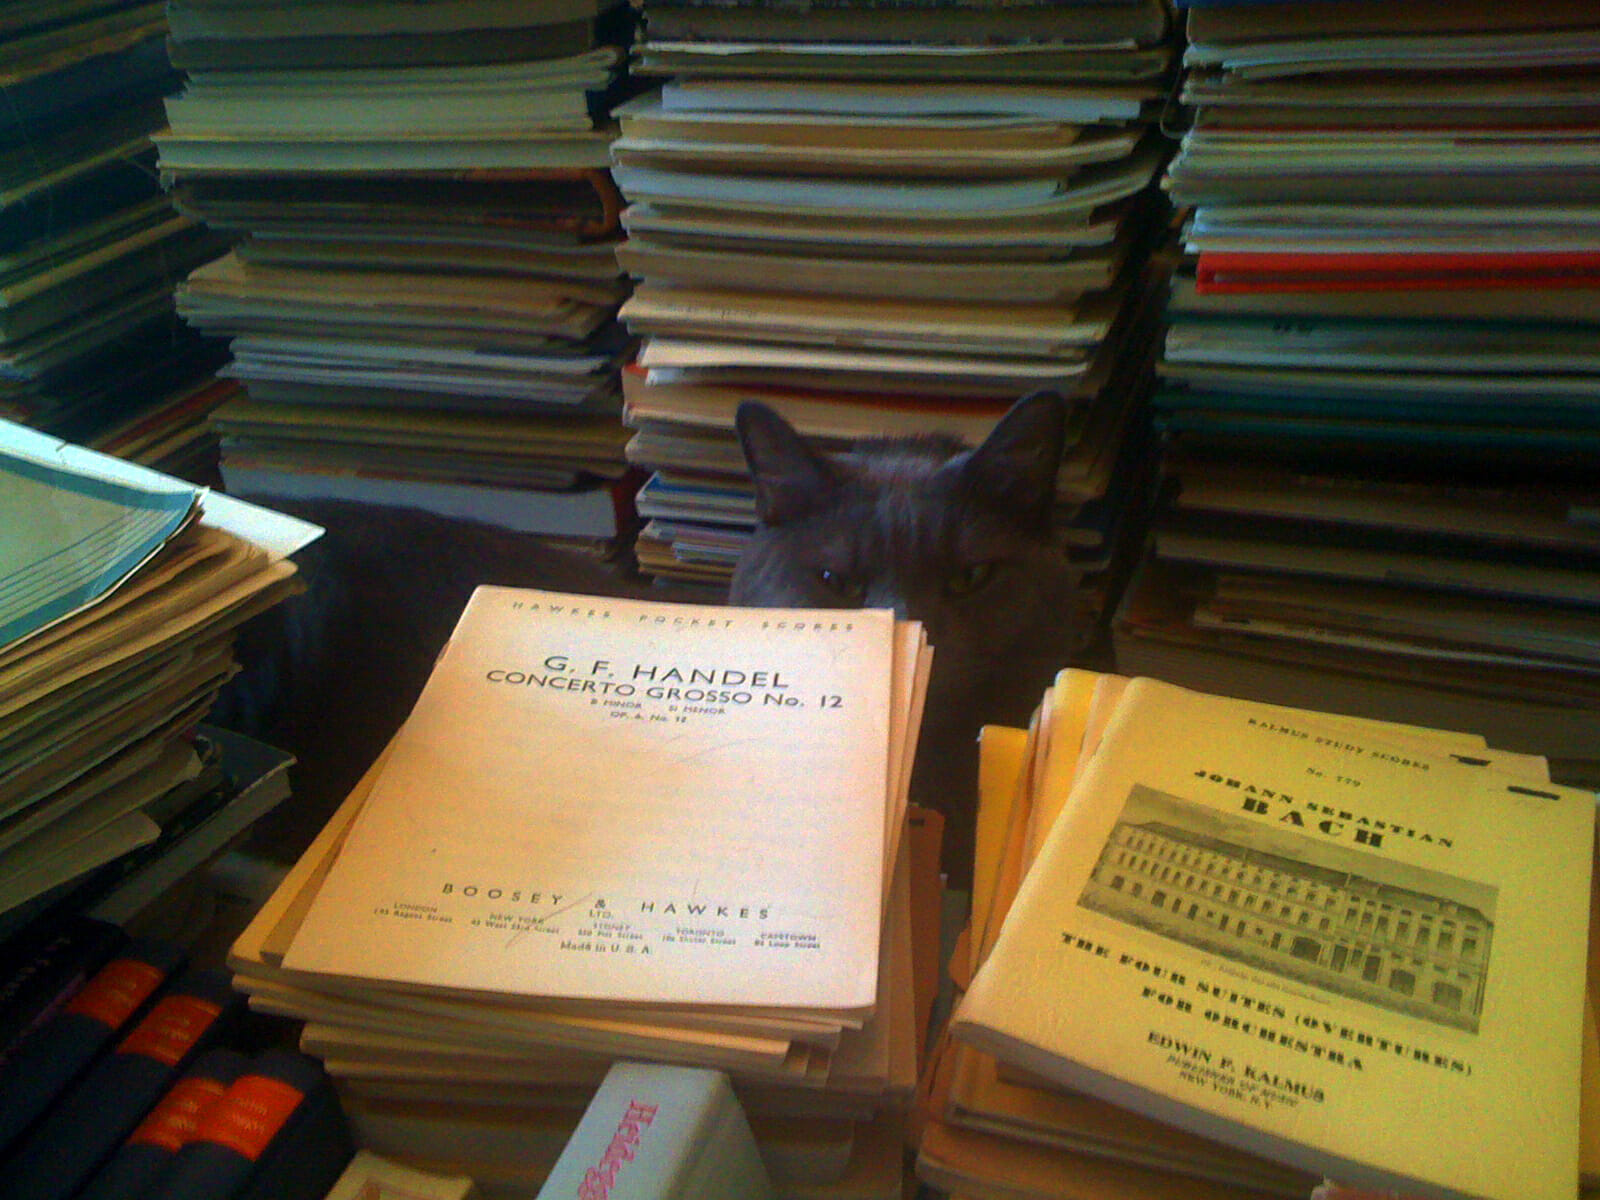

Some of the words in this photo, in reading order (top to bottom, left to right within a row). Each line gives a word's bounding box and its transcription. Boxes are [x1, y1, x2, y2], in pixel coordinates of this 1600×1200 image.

[513, 601, 612, 619] HAWKES
[638, 614, 734, 628] POCKET
[762, 620, 854, 633] SCORES
[486, 670, 636, 697] CONCERTO
[646, 686, 753, 705] GROSSO
[762, 693, 805, 709] No.
[820, 695, 844, 710] 12
[544, 656, 574, 674] G.
[591, 660, 614, 679] F.
[632, 665, 790, 689] HANDEL
[602, 699, 642, 709] MINOR
[1248, 717, 1309, 741] KALMUS
[1314, 736, 1365, 754] STUDY
[1371, 750, 1430, 771] SCORES
[1193, 770, 1294, 805] JOHANN
[1306, 801, 1453, 848] SEBASTIAN
[1241, 797, 1383, 848] BACH
[442, 883, 562, 906] BOOSEY
[594, 899, 606, 910] &
[641, 902, 768, 919] HAWKES
[1061, 931, 1108, 959] THE
[1118, 952, 1187, 986] FOUR
[1195, 978, 1287, 1020] SUITES
[1294, 1013, 1473, 1077] (OVERTURES)
[1141, 986, 1193, 1014] FOR
[1204, 1009, 1364, 1072] ORCHESTRA
[1148, 1030, 1212, 1064] EDWIN
[1245, 1064, 1325, 1103] KALMUS
